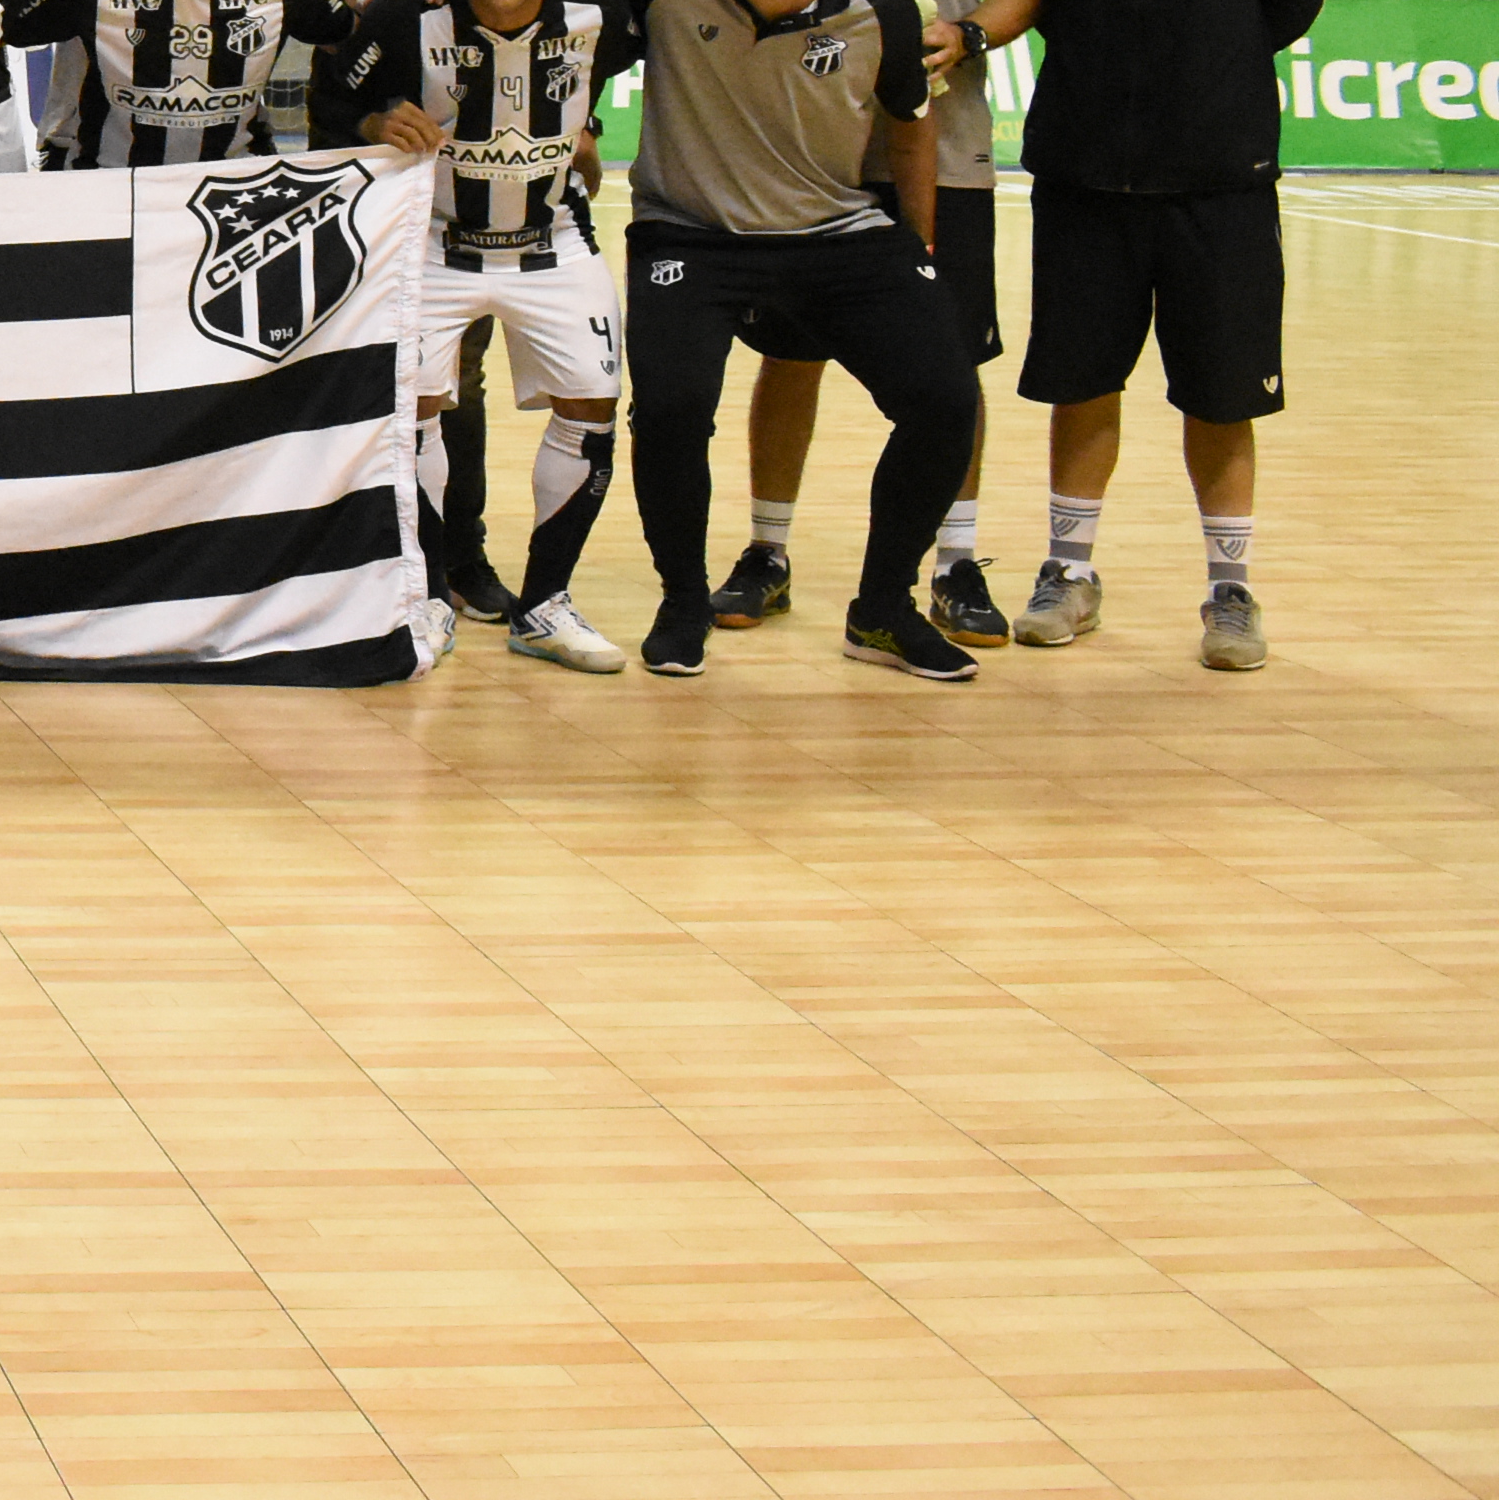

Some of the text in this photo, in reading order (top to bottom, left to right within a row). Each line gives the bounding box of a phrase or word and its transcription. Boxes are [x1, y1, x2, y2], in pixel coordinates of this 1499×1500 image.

[169, 24, 214, 60] 29
[500, 76, 523, 112] 4
[1277, 36, 1499, 121] icre
[115, 89, 257, 113] RAMACON
[439, 139, 574, 166] RAMACON
[269, 327, 294, 342] 1914
[589, 316, 613, 352] 4
